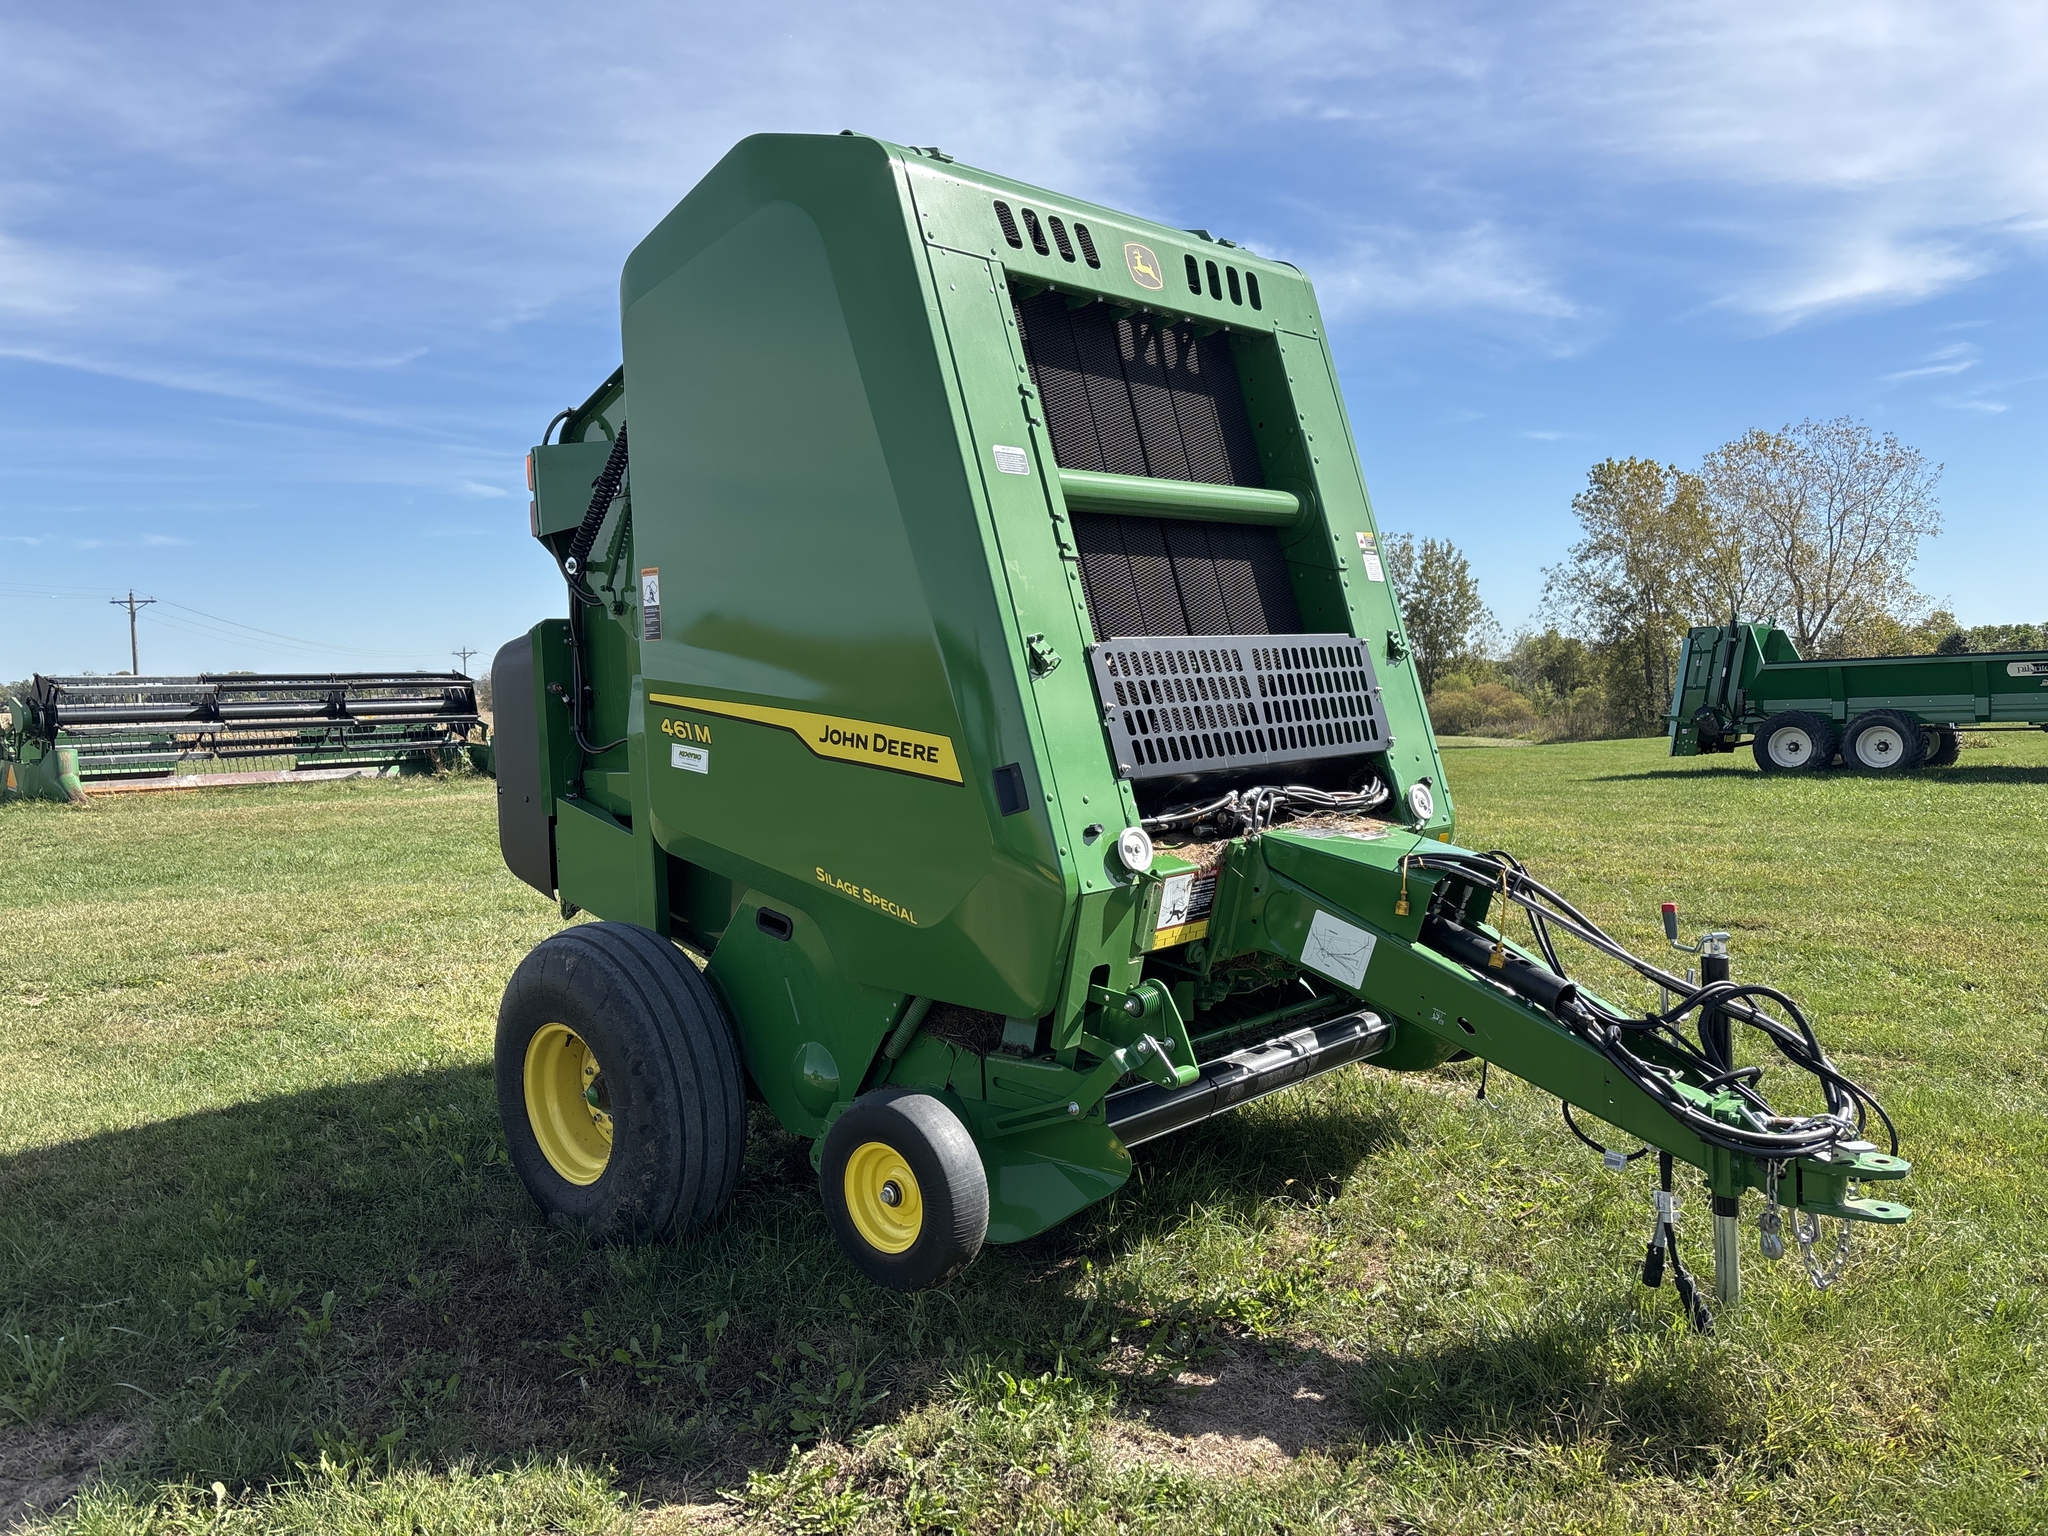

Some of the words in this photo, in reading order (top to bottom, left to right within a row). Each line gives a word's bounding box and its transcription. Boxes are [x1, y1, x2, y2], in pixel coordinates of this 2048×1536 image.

[819, 725, 868, 750] JOHN
[873, 733, 939, 764] DEERE
[815, 866, 861, 899] SILAGE
[862, 888, 918, 925] SPECIAL
